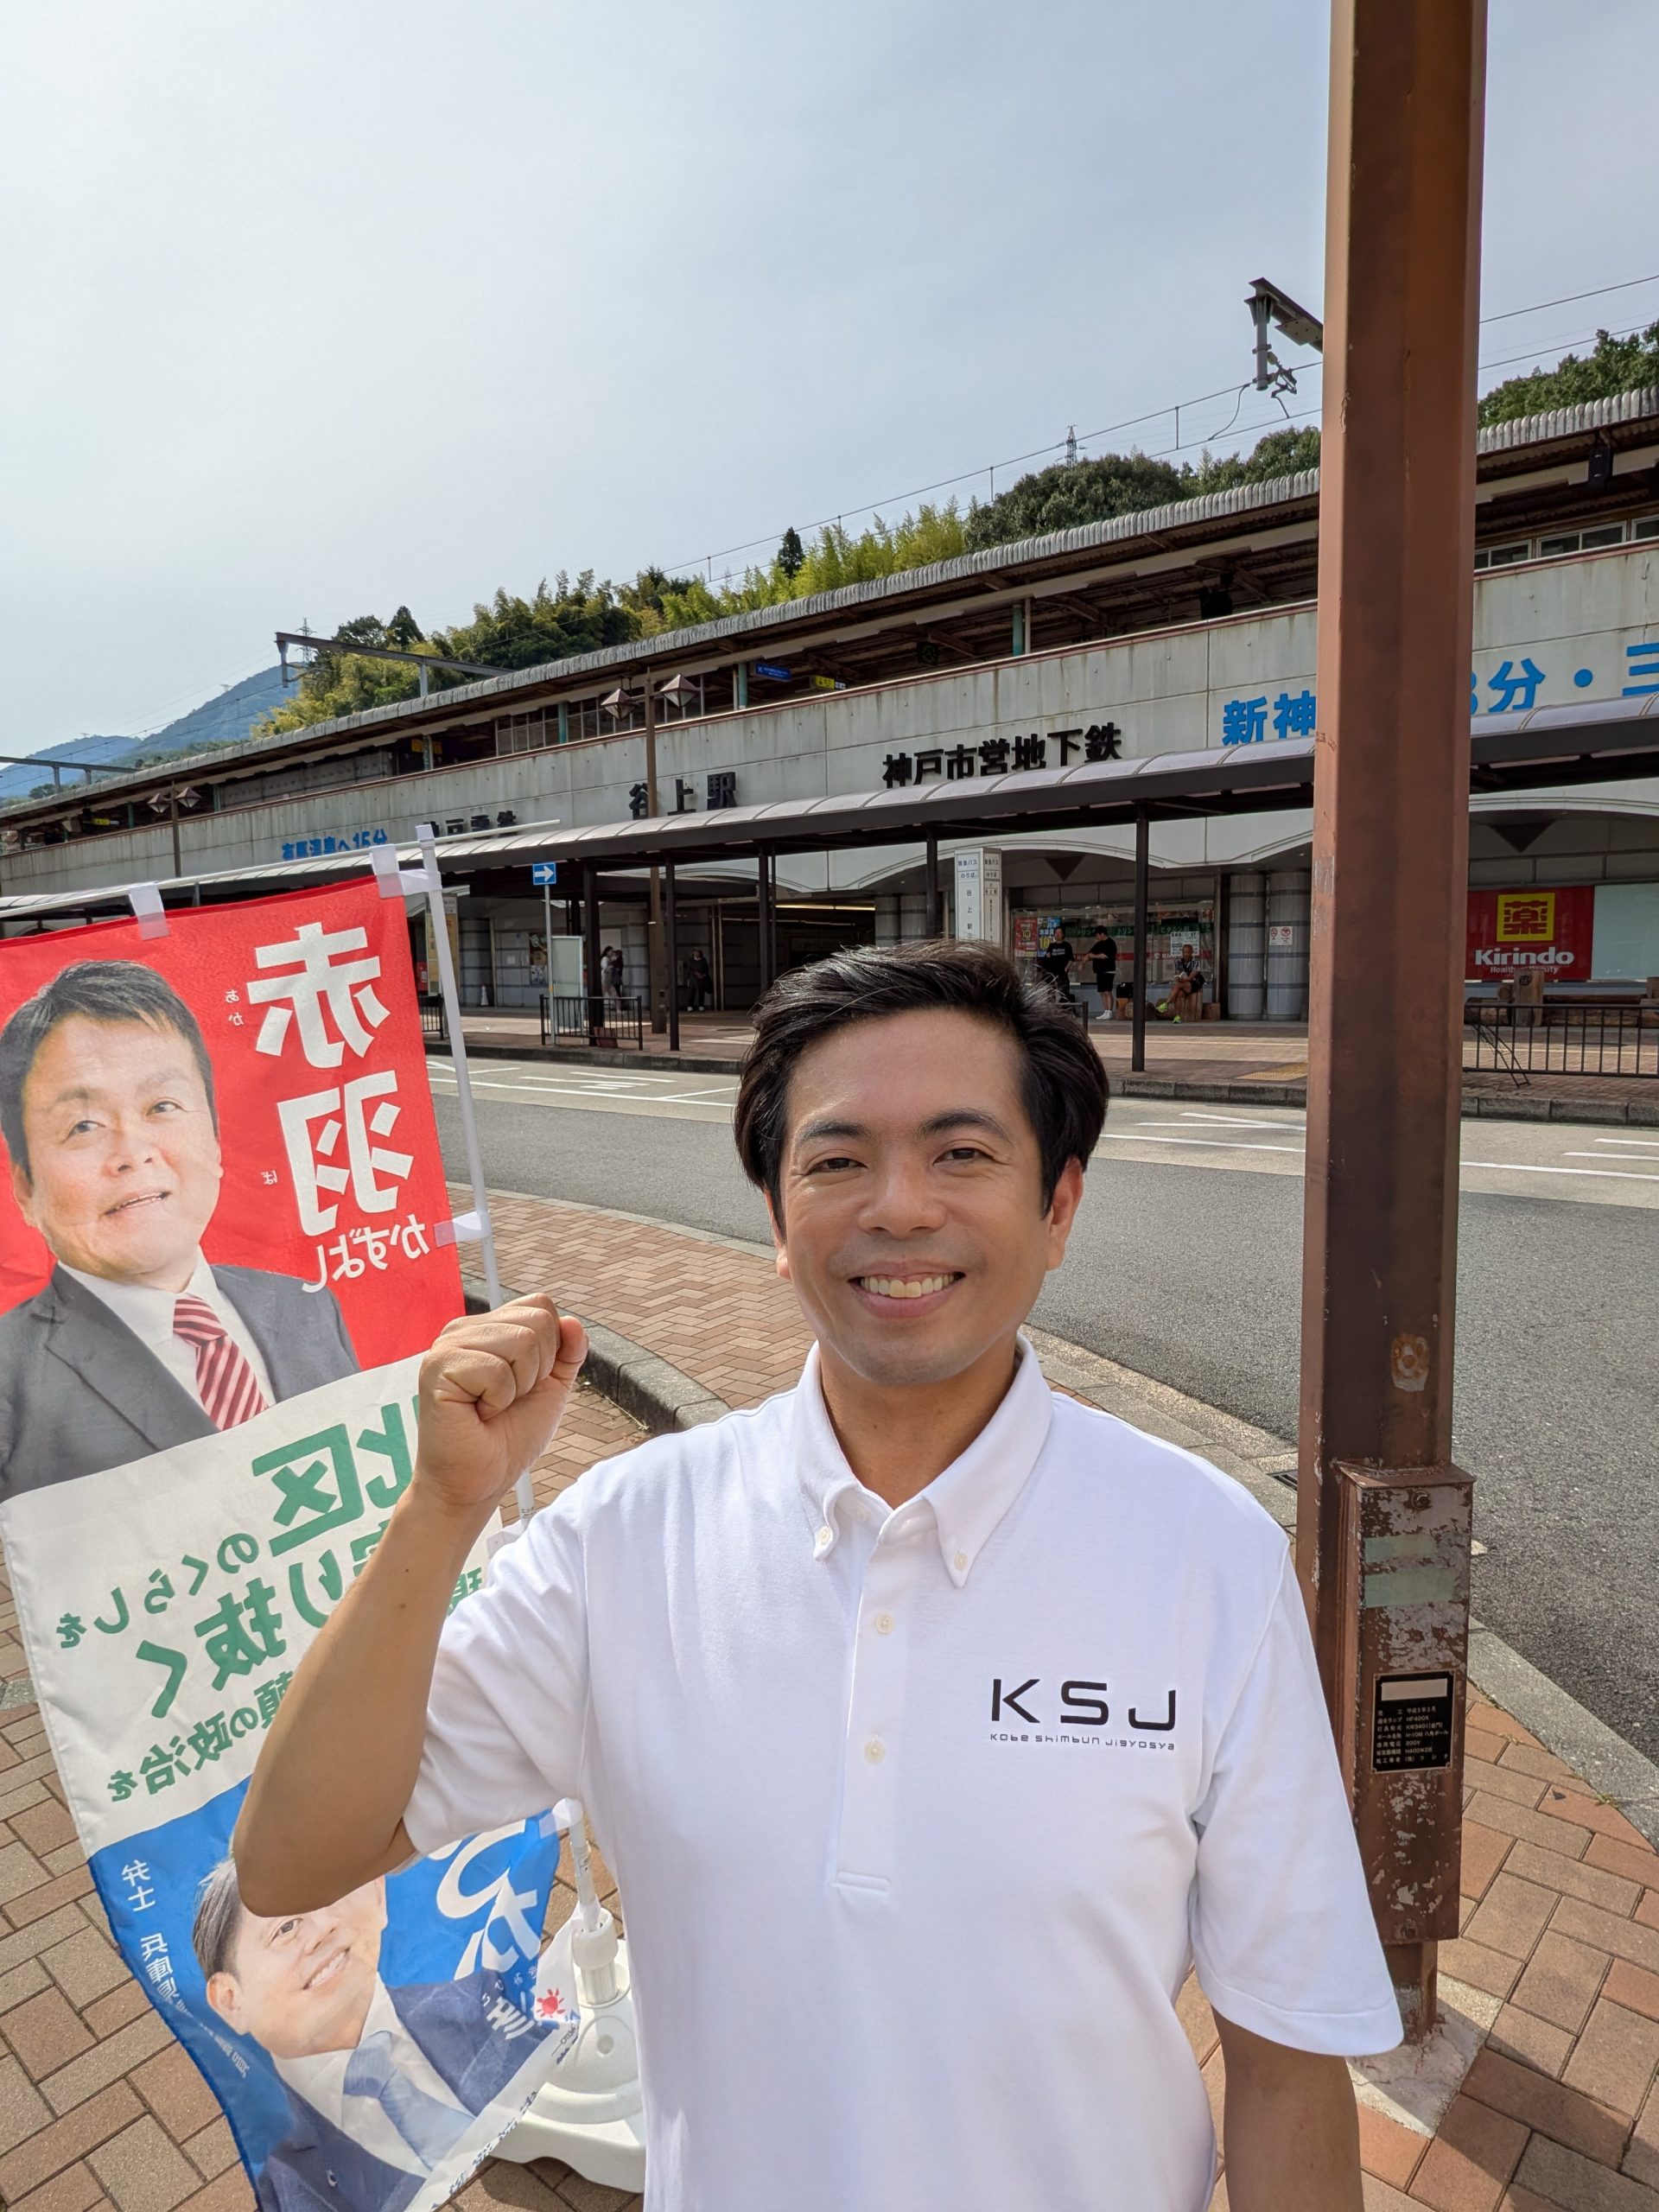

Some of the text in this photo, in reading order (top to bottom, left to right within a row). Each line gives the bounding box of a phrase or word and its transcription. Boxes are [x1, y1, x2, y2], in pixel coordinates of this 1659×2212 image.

[1222, 690, 1317, 746] 新神
[882, 721, 1123, 789] 神戸市営地下鉄
[628, 772, 737, 820] 谷上駅
[1475, 947, 1574, 965] Kirindo
[991, 1679, 1176, 1731] KSJ
